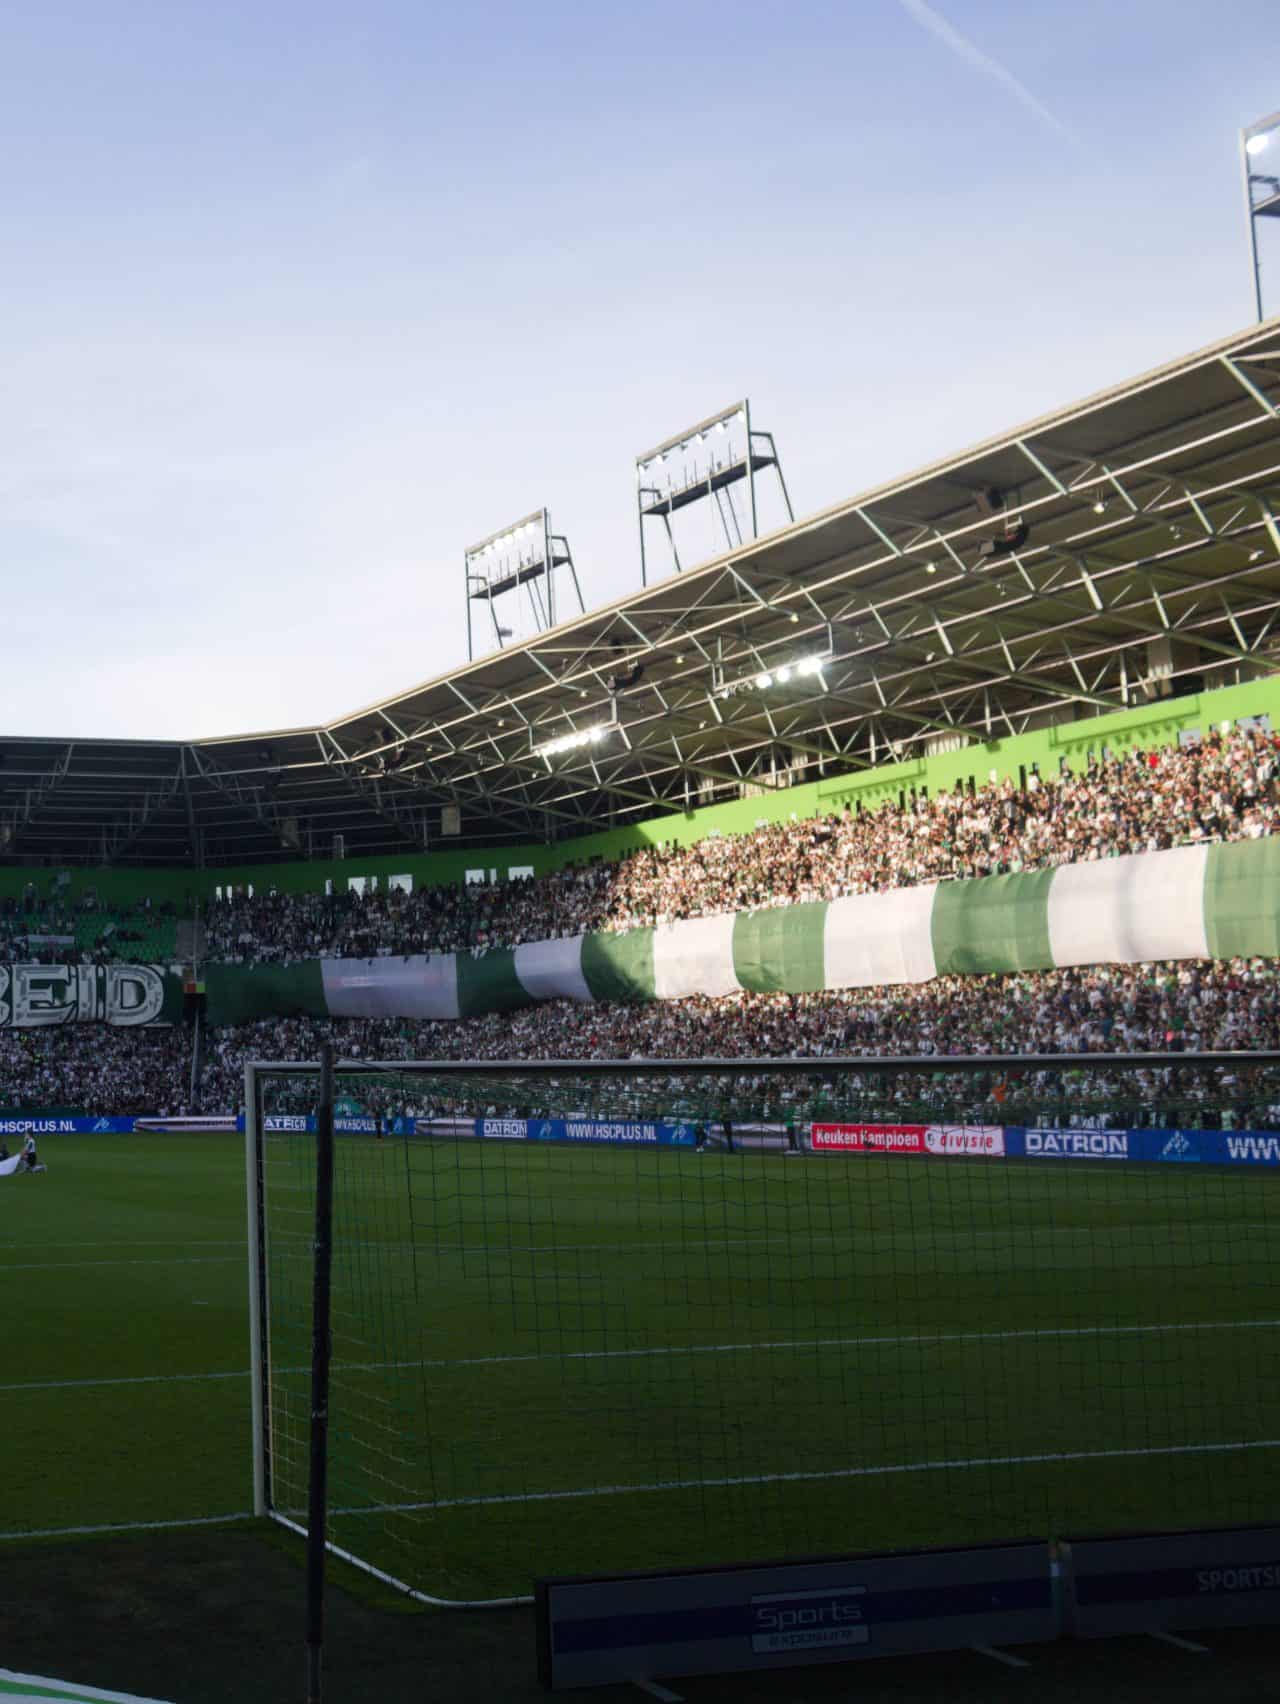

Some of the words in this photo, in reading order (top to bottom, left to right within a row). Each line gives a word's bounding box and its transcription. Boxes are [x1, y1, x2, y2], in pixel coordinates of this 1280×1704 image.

[483, 1121, 528, 1136] DATRON
[565, 1122, 657, 1141] WWW.HSCPLUS.NL
[815, 1127, 858, 1146] Keuken
[860, 1129, 919, 1150] Kampioen
[1024, 1133, 1129, 1153] DATRON
[756, 1601, 862, 1632] Sports
